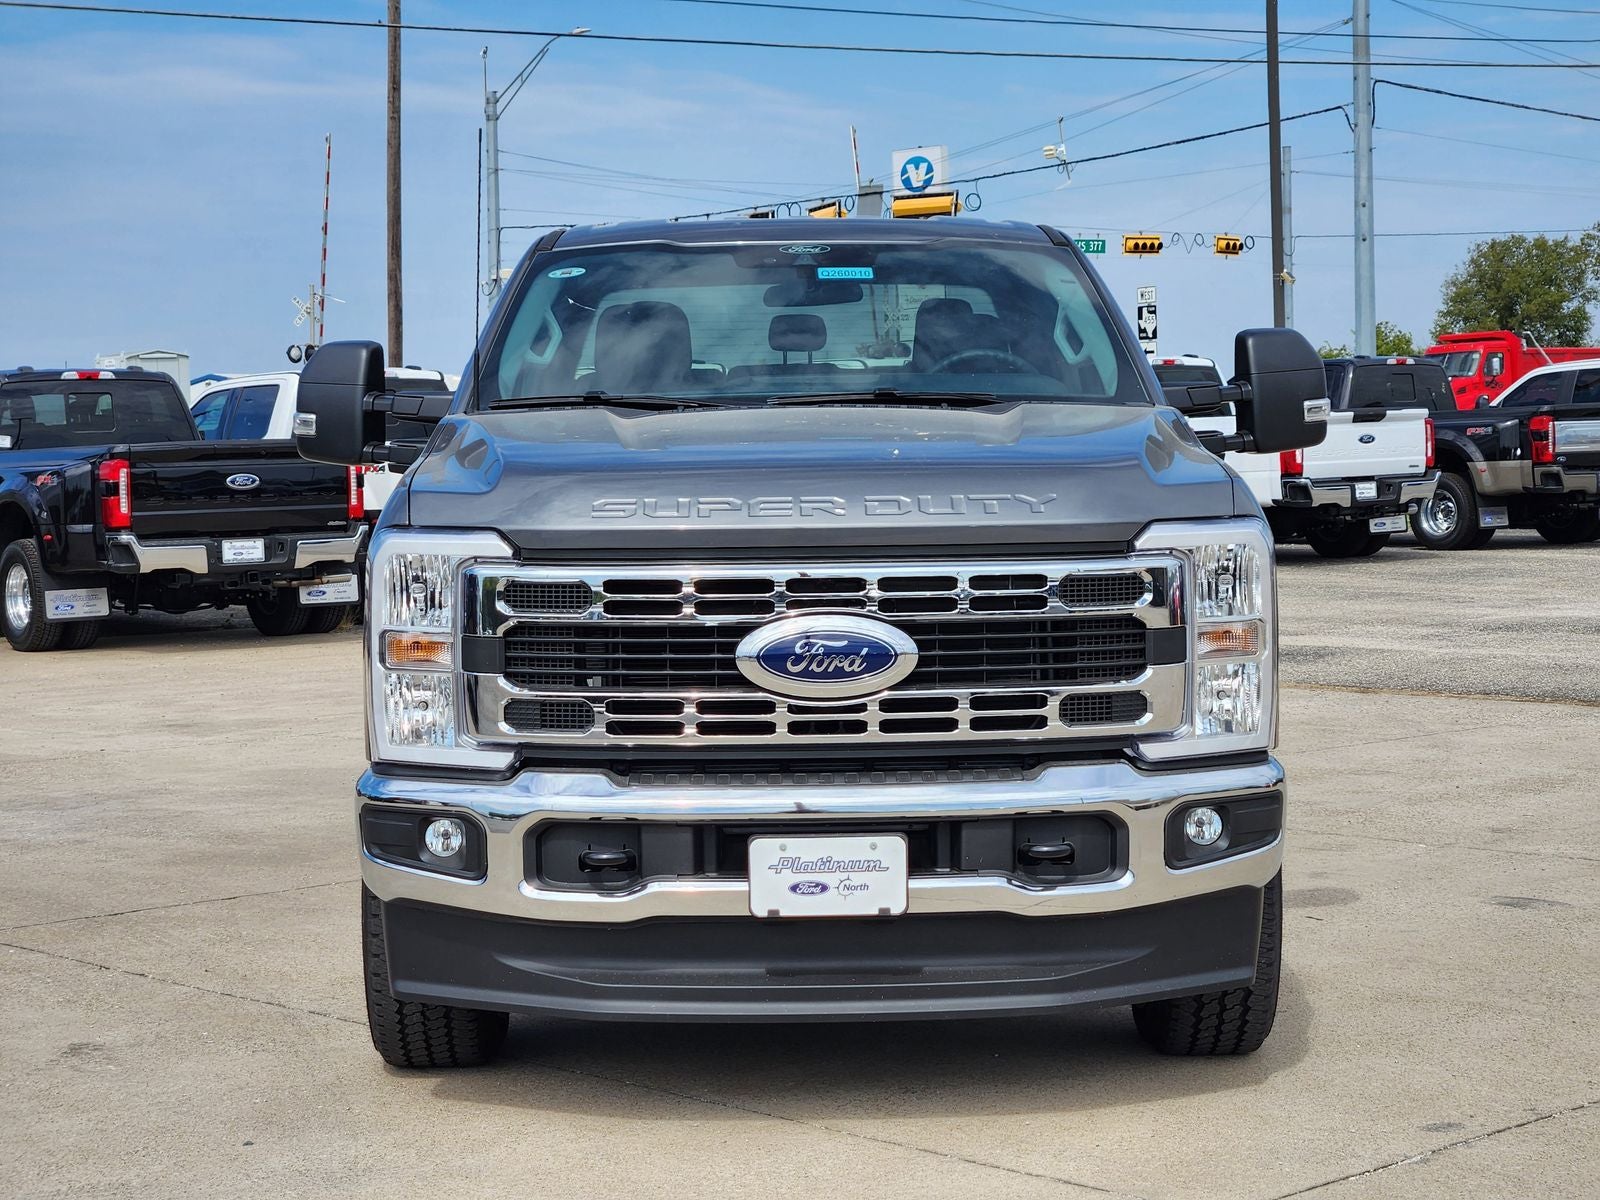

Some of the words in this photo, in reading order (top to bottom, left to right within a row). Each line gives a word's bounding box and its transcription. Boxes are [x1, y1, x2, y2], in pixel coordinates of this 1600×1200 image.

[788, 244, 822, 254] Ford
[1089, 241, 1103, 251] 377
[821, 270, 871, 278] Q260010
[1140, 290, 1154, 300] WEST
[1144, 315, 1155, 324] 455
[235, 476, 252, 485] Ford
[591, 497, 846, 518] SUPER
[864, 494, 1057, 515] DUTY
[786, 639, 869, 673] Ford
[768, 856, 889, 874] Platinum
[796, 882, 823, 894] Ford
[842, 883, 869, 892] North
